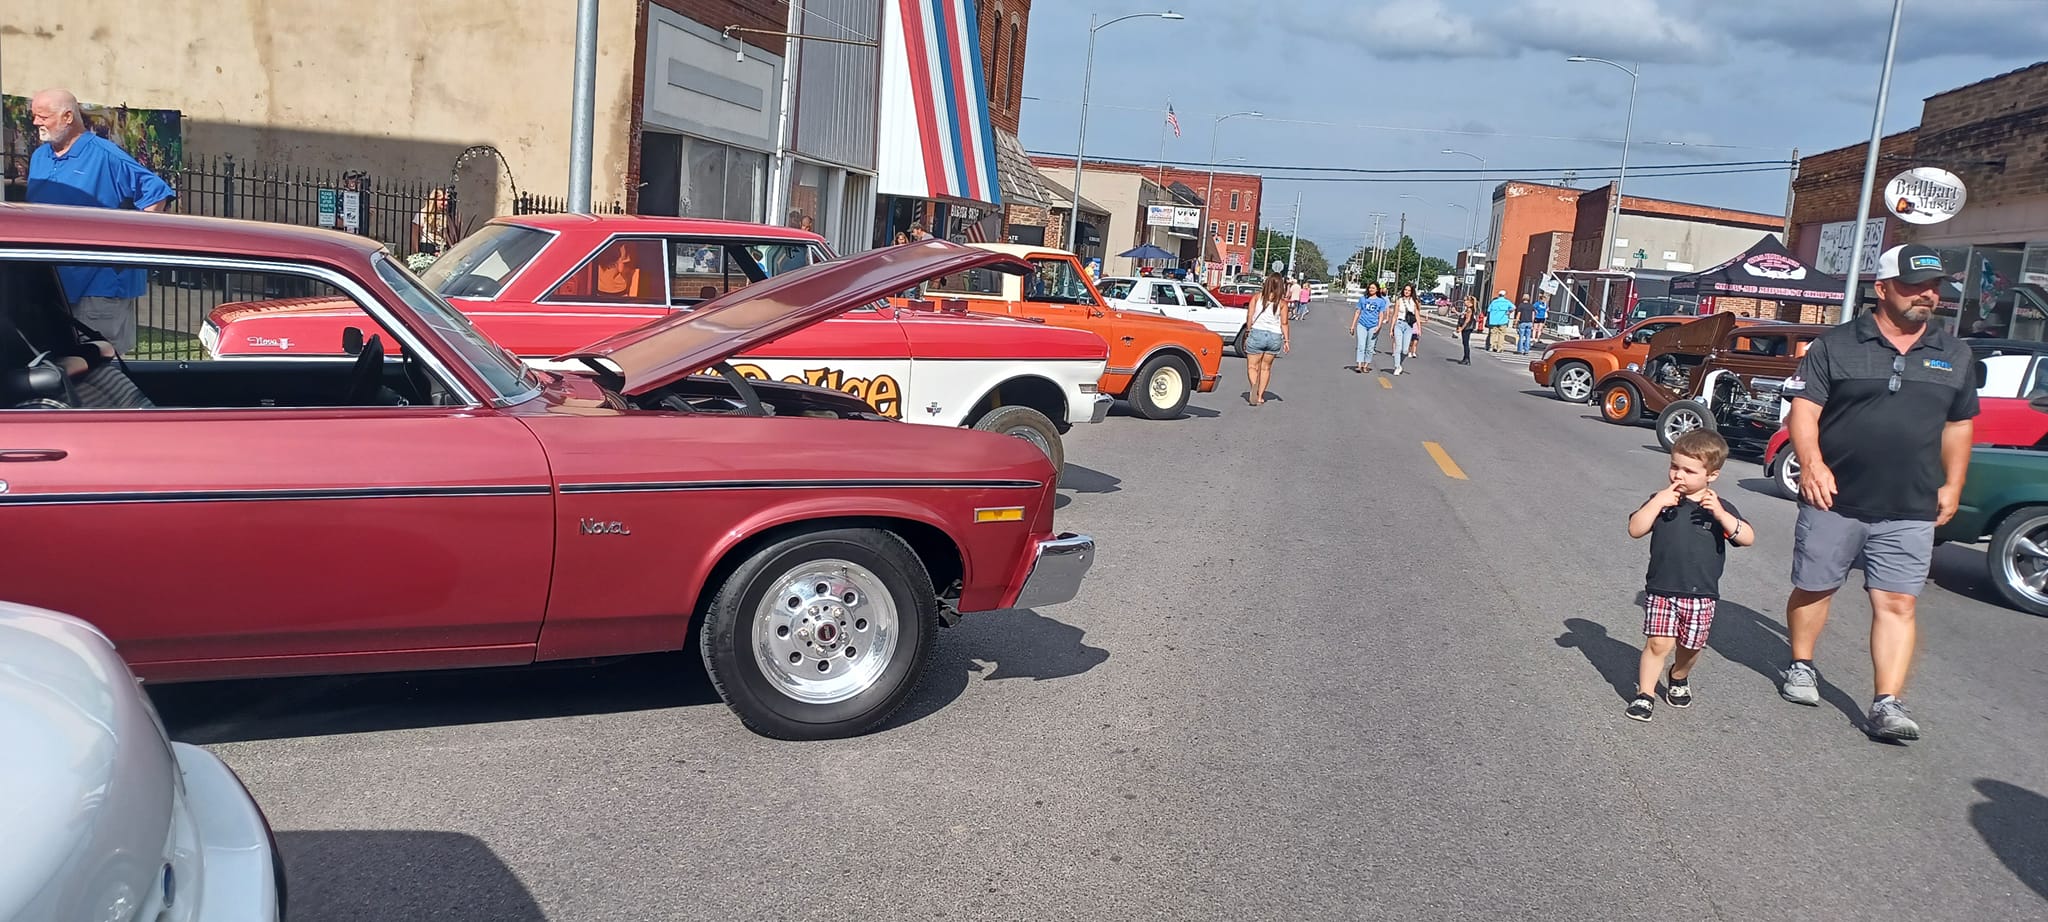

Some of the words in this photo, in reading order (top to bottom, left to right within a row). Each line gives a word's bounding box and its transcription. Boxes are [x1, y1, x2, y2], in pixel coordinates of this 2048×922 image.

[1896, 179, 1957, 199] Brillhart
[1917, 197, 1956, 211] Music
[246, 337, 278, 346] Nova
[580, 517, 632, 536] Nova
